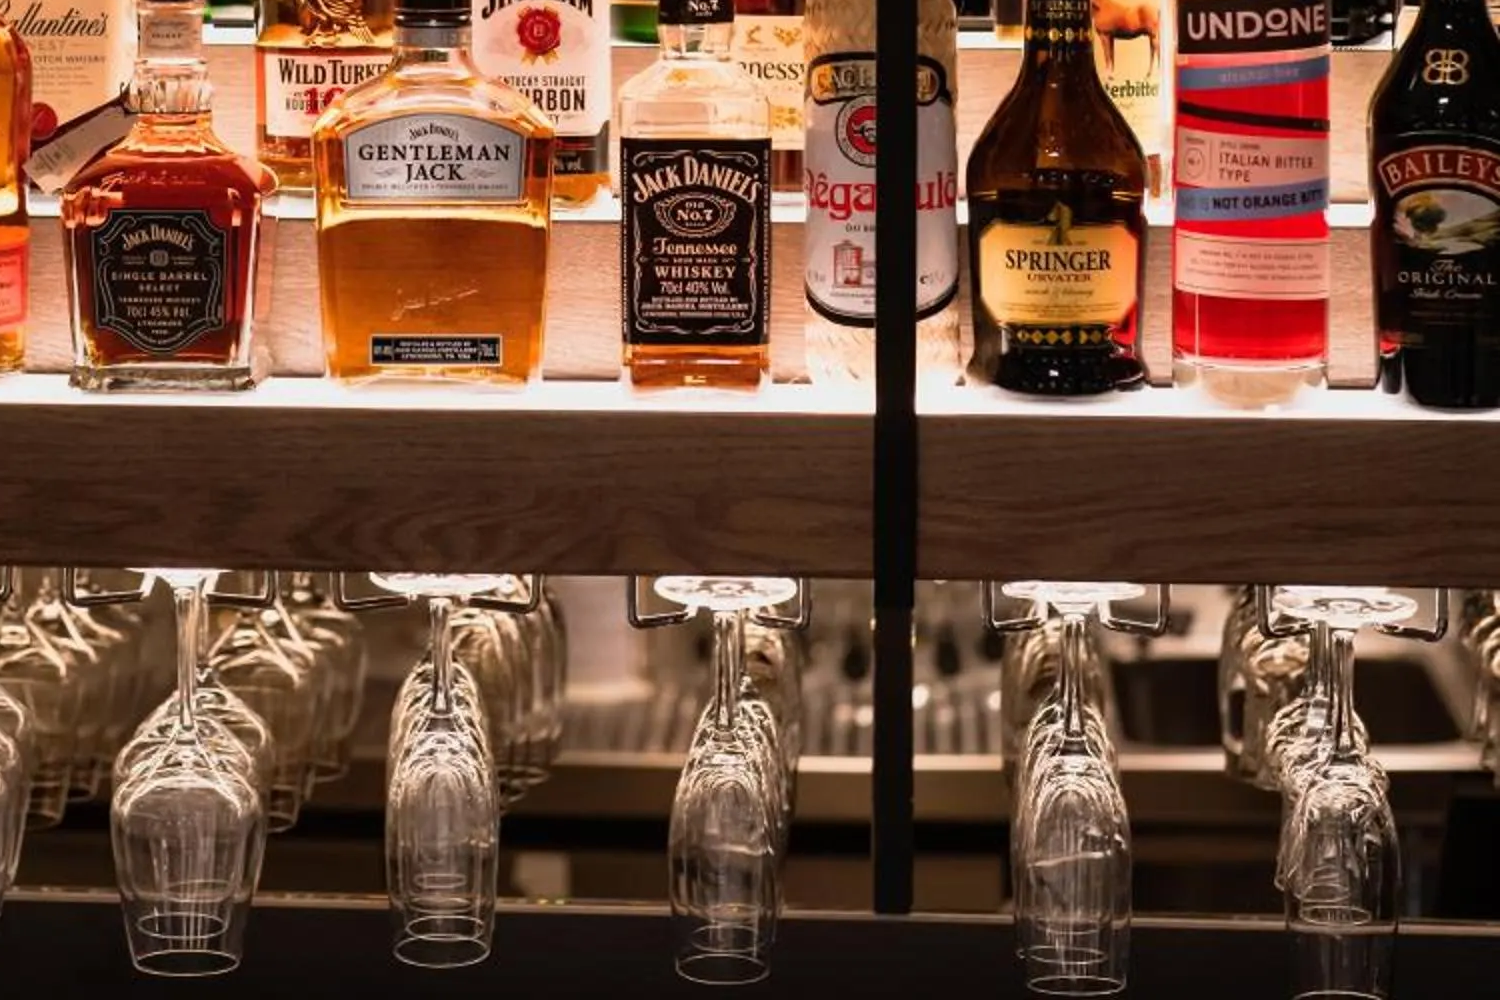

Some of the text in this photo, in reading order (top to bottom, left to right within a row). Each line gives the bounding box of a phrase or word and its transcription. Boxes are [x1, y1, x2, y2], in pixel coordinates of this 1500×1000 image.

[1187, 3, 1326, 41] UNDONE
[278, 58, 327, 85] WILD
[542, 75, 586, 87] STRAIGHT
[357, 143, 512, 161] GENTLEMAN
[1218, 151, 1271, 169] ITALIAN
[405, 162, 468, 184] JACK
[631, 154, 763, 204] JACK DANIEL'S
[1218, 169, 1251, 183] TYPE
[1211, 196, 1239, 211] NOT
[1242, 193, 1298, 210] ORANGE
[676, 208, 714, 222] No.7
[121, 228, 150, 251] JACK
[652, 236, 738, 256] Tennessee
[1004, 249, 1112, 271] SPRINGER
[111, 271, 209, 281] SINGLE BARREL
[654, 265, 737, 279] WHISKEY
[1397, 271, 1497, 286] ORIGINAL
